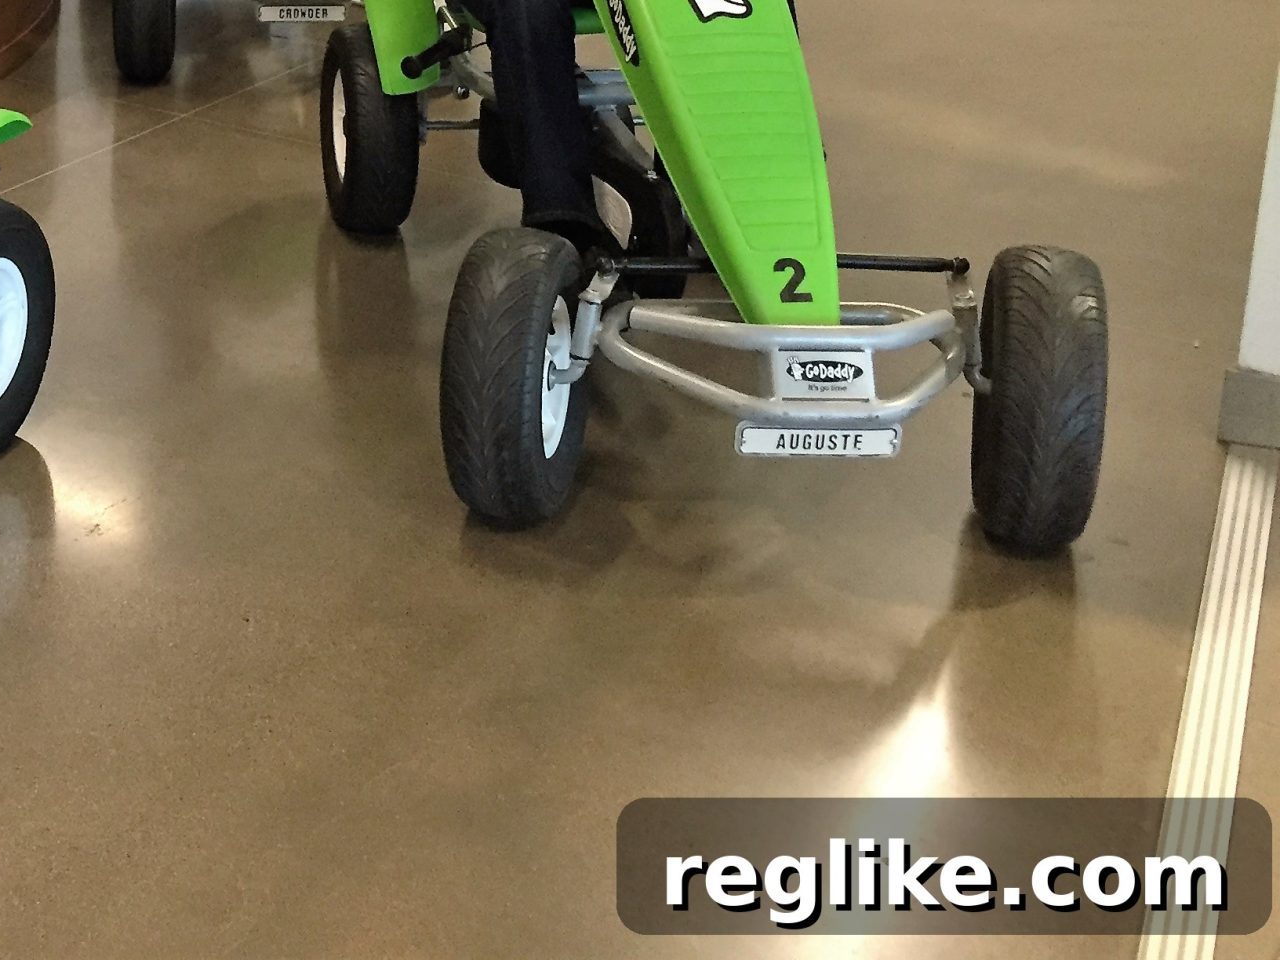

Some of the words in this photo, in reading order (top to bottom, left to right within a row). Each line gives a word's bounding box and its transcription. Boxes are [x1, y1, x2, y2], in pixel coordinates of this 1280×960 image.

[773, 257, 814, 303] 2
[805, 362, 856, 383] GoDaddy
[776, 433, 864, 451] AUGUSTE
